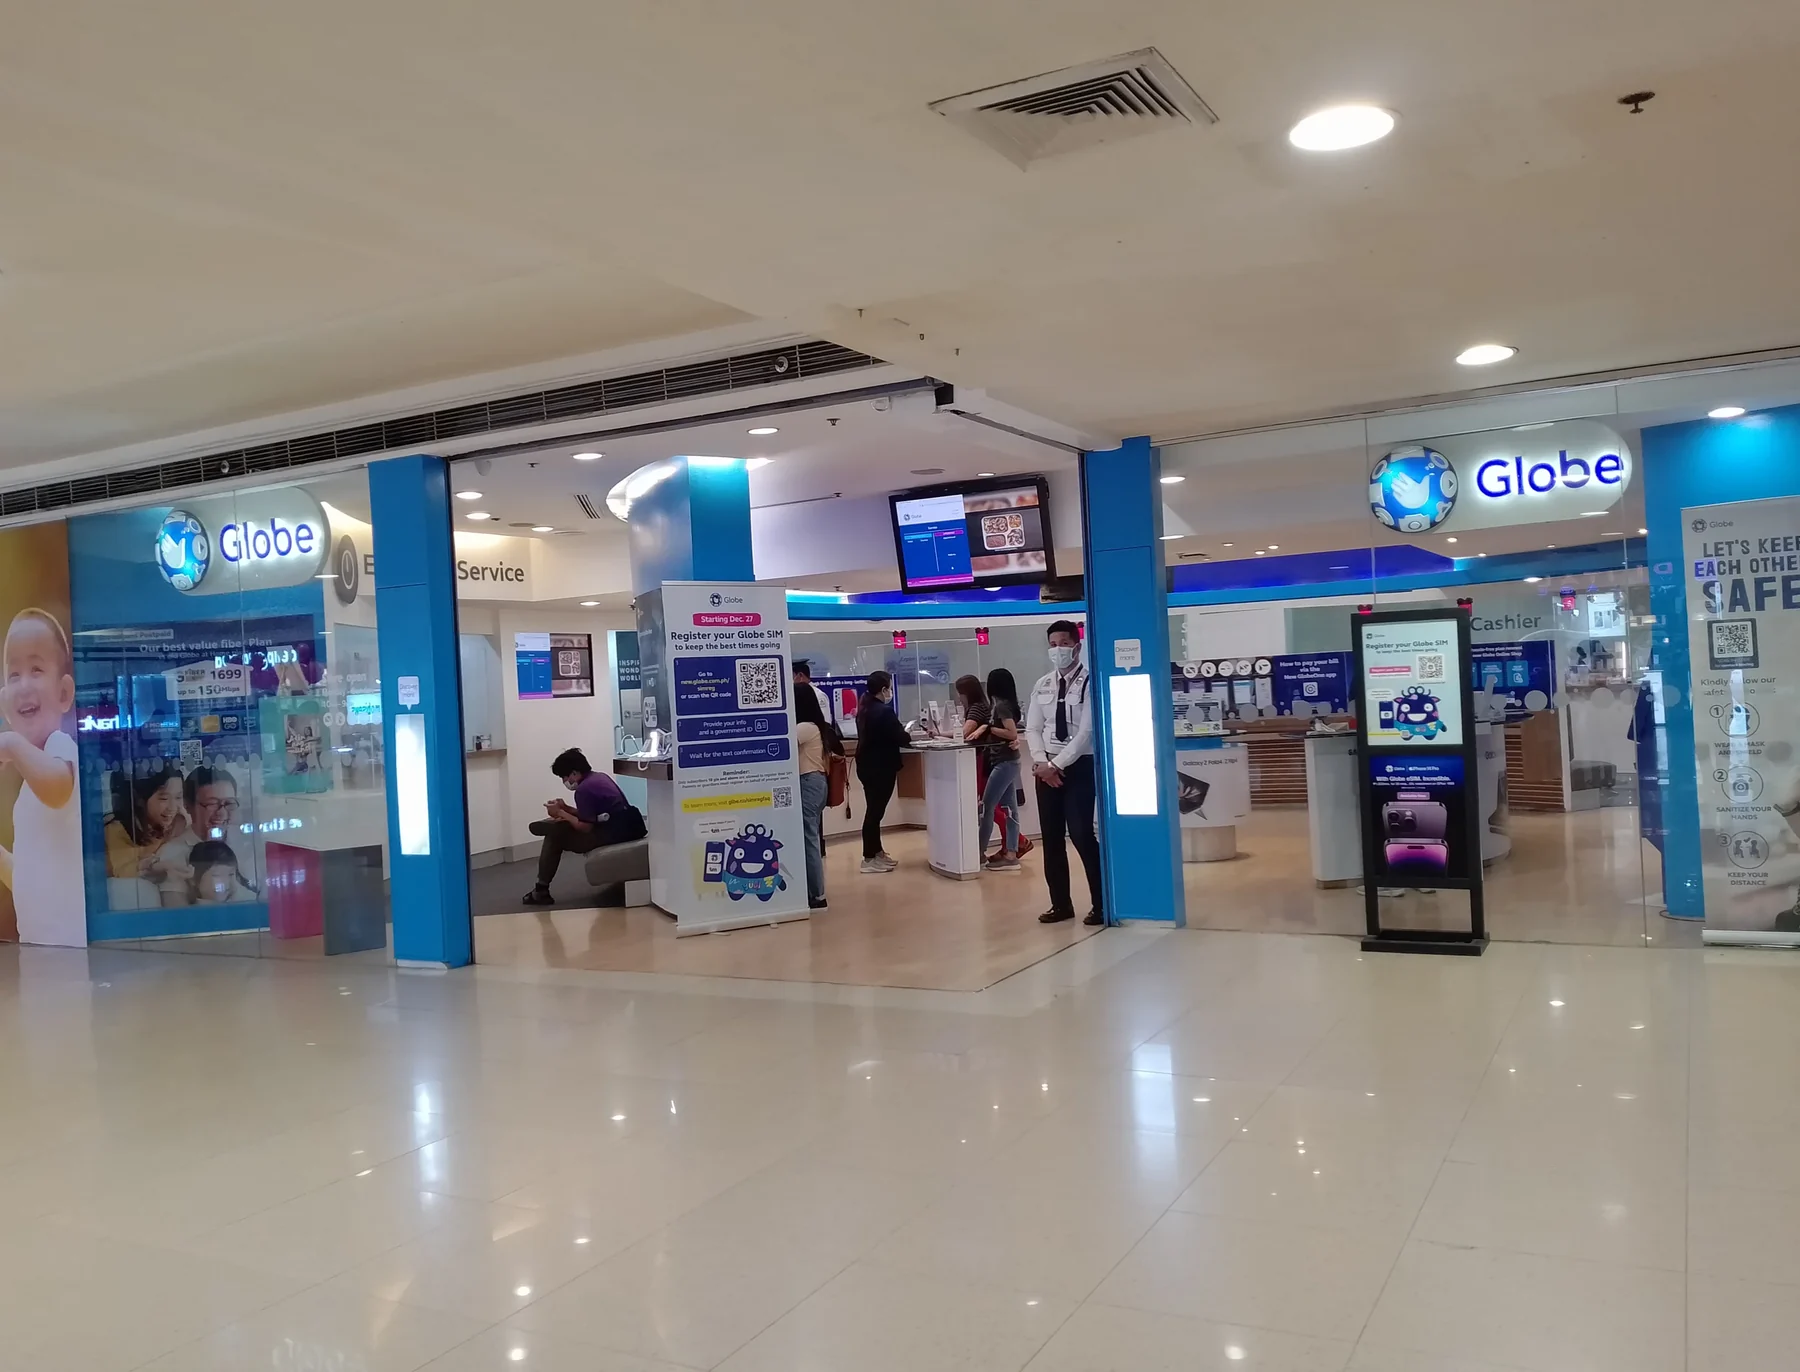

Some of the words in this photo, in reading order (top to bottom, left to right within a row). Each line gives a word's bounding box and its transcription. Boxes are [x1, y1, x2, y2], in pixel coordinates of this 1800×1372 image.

[1476, 450, 1624, 498] Globe
[1709, 520, 1734, 528] Globe
[219, 517, 314, 563] Globe
[1703, 539, 1750, 558] LET'S
[457, 560, 525, 582] Service
[1694, 559, 1742, 577] EACH
[1750, 555, 1800, 574] OTHE
[1702, 574, 1800, 614] SAFE
[700, 616, 728, 624] Starting
[1470, 614, 1542, 631] Cashier
[670, 631, 712, 642] Register
[714, 632, 736, 642] your
[738, 630, 764, 640] Globe
[766, 630, 784, 638] SIM
[140, 644, 162, 652] Our
[162, 642, 186, 652] best
[188, 640, 218, 650] value
[248, 638, 272, 647] Plan
[685, 643, 704, 652] keep
[760, 642, 780, 650] going
[210, 669, 242, 680] 1699
[1714, 707, 1720, 715] 1
[715, 727, 746, 735] government
[1717, 771, 1724, 780] 2
[1721, 836, 1728, 845] 3
